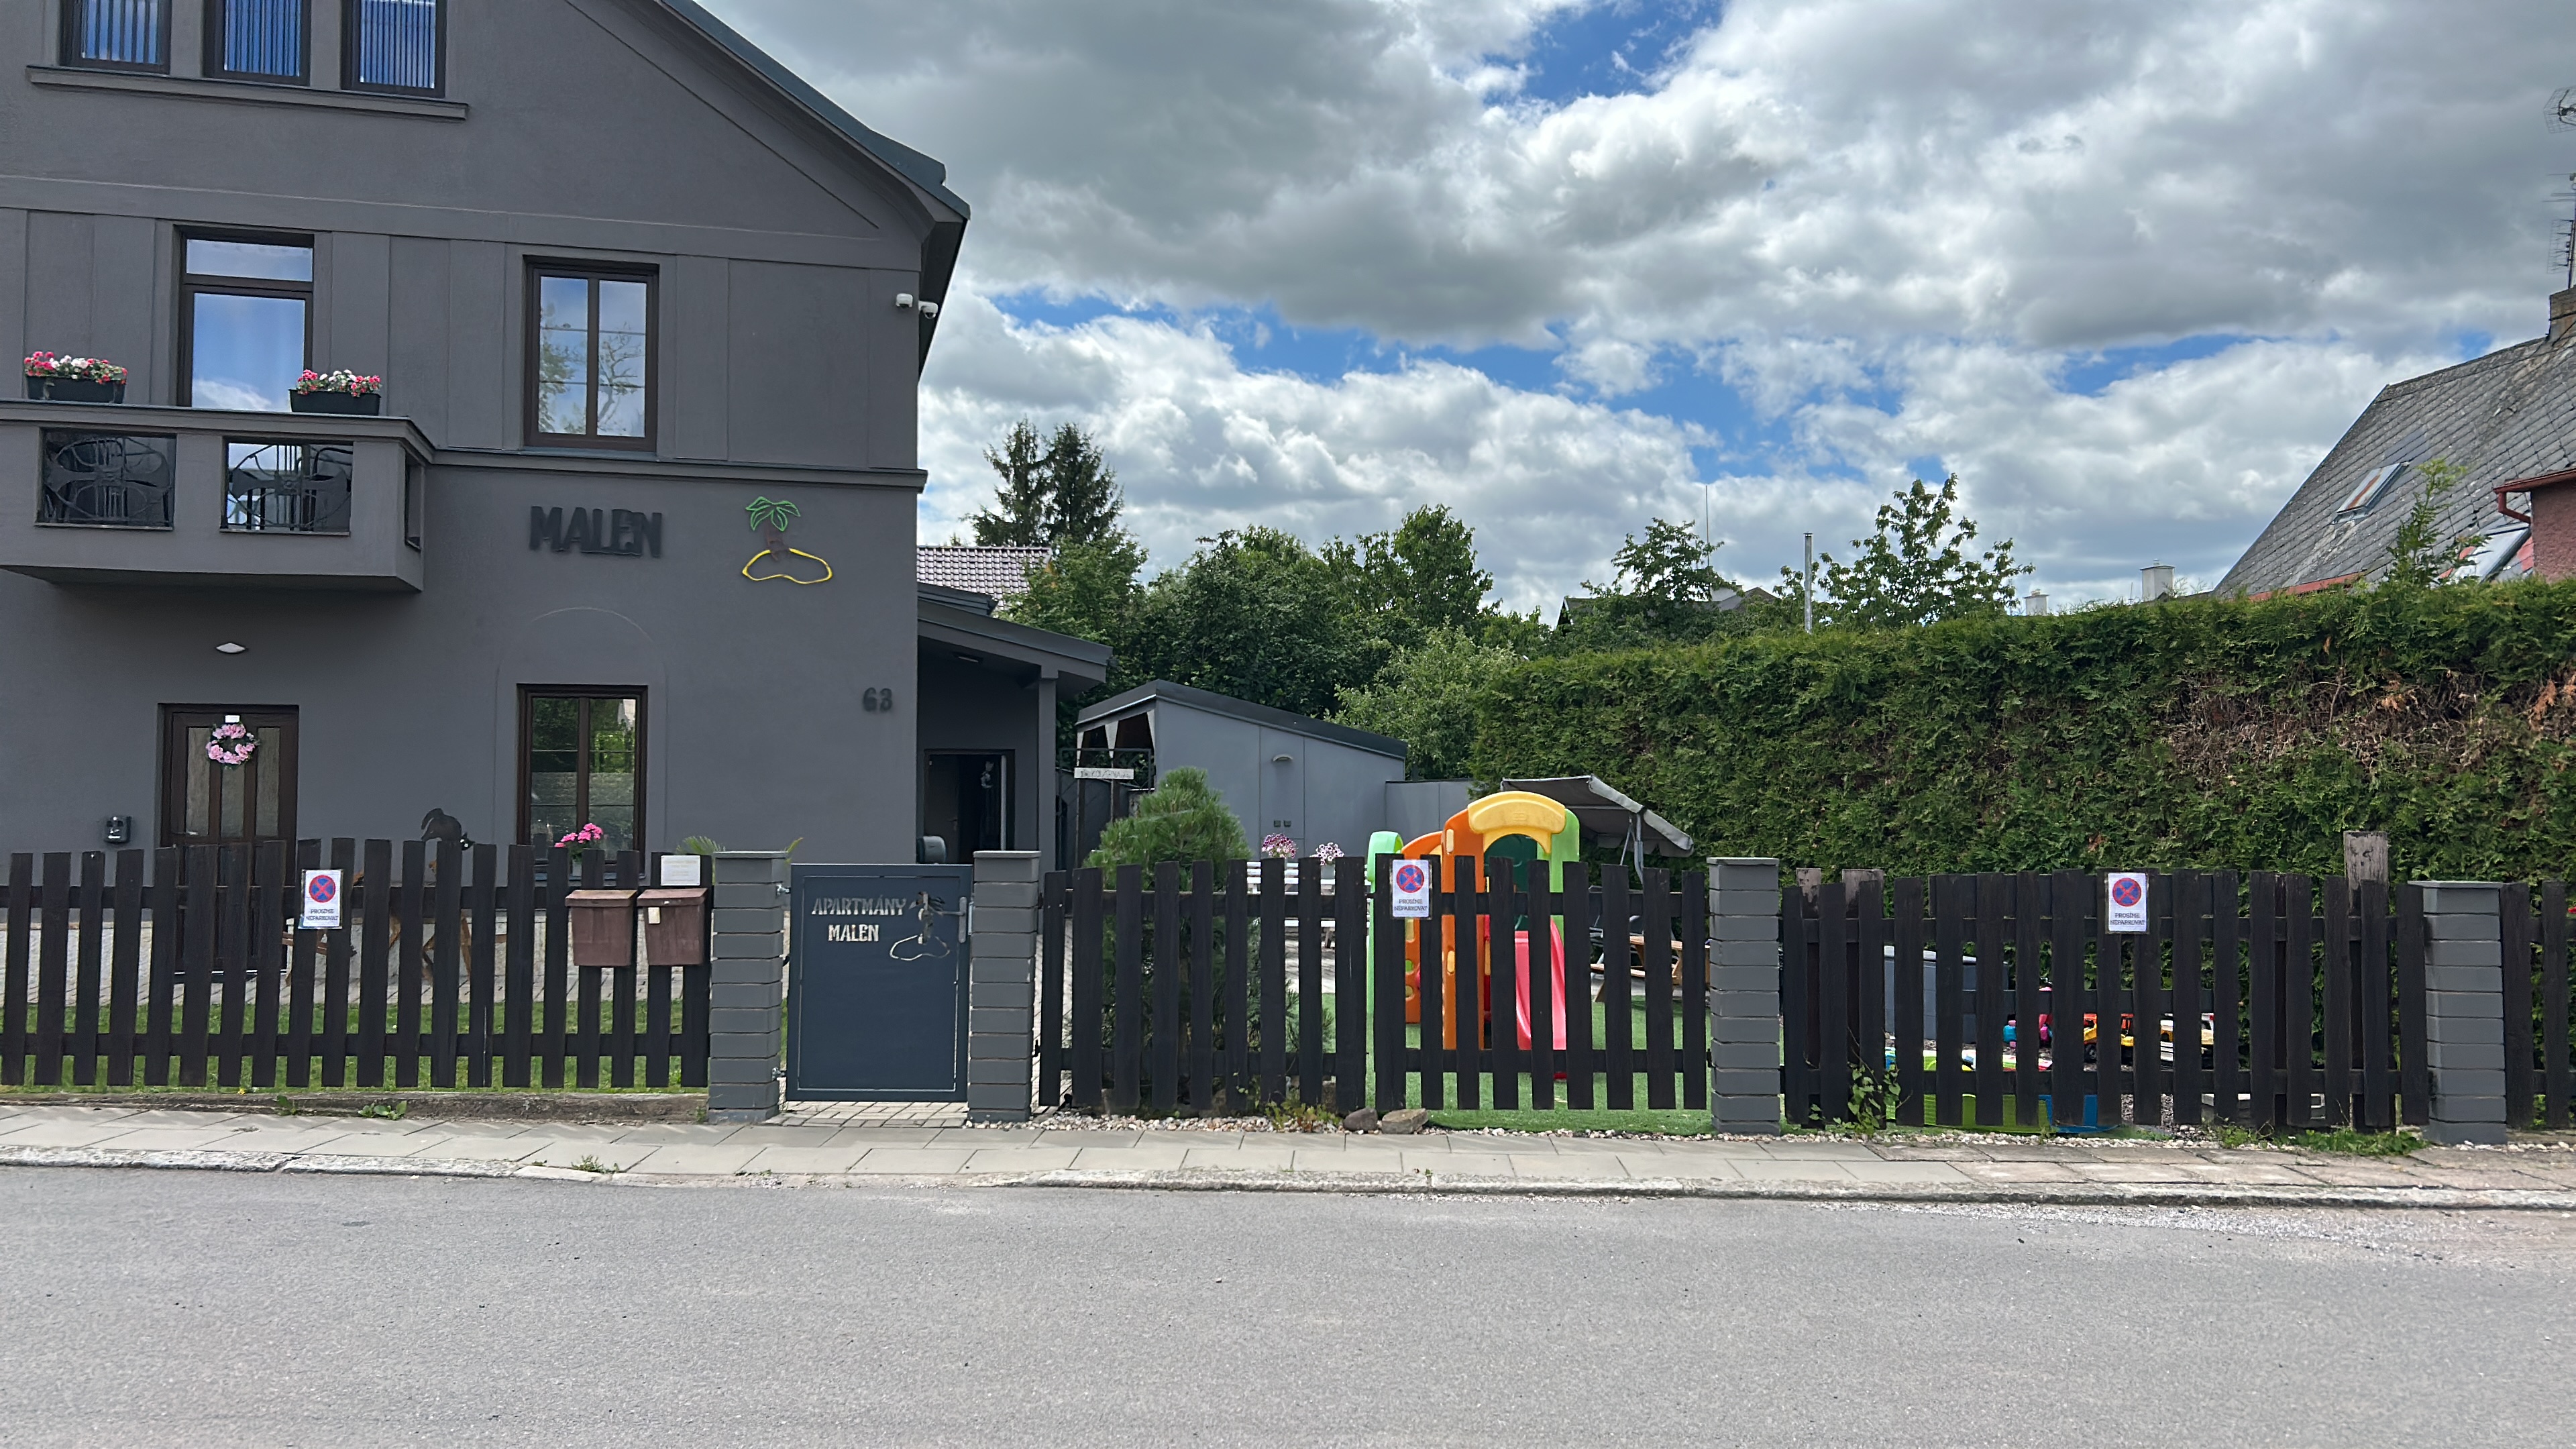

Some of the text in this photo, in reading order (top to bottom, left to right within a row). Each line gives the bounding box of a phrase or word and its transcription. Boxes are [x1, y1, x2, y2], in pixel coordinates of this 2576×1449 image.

[529, 506, 662, 558] MALEN
[863, 687, 893, 713] 63
[812, 895, 907, 915] APARTMÁNY
[828, 924, 879, 942] MALEN
